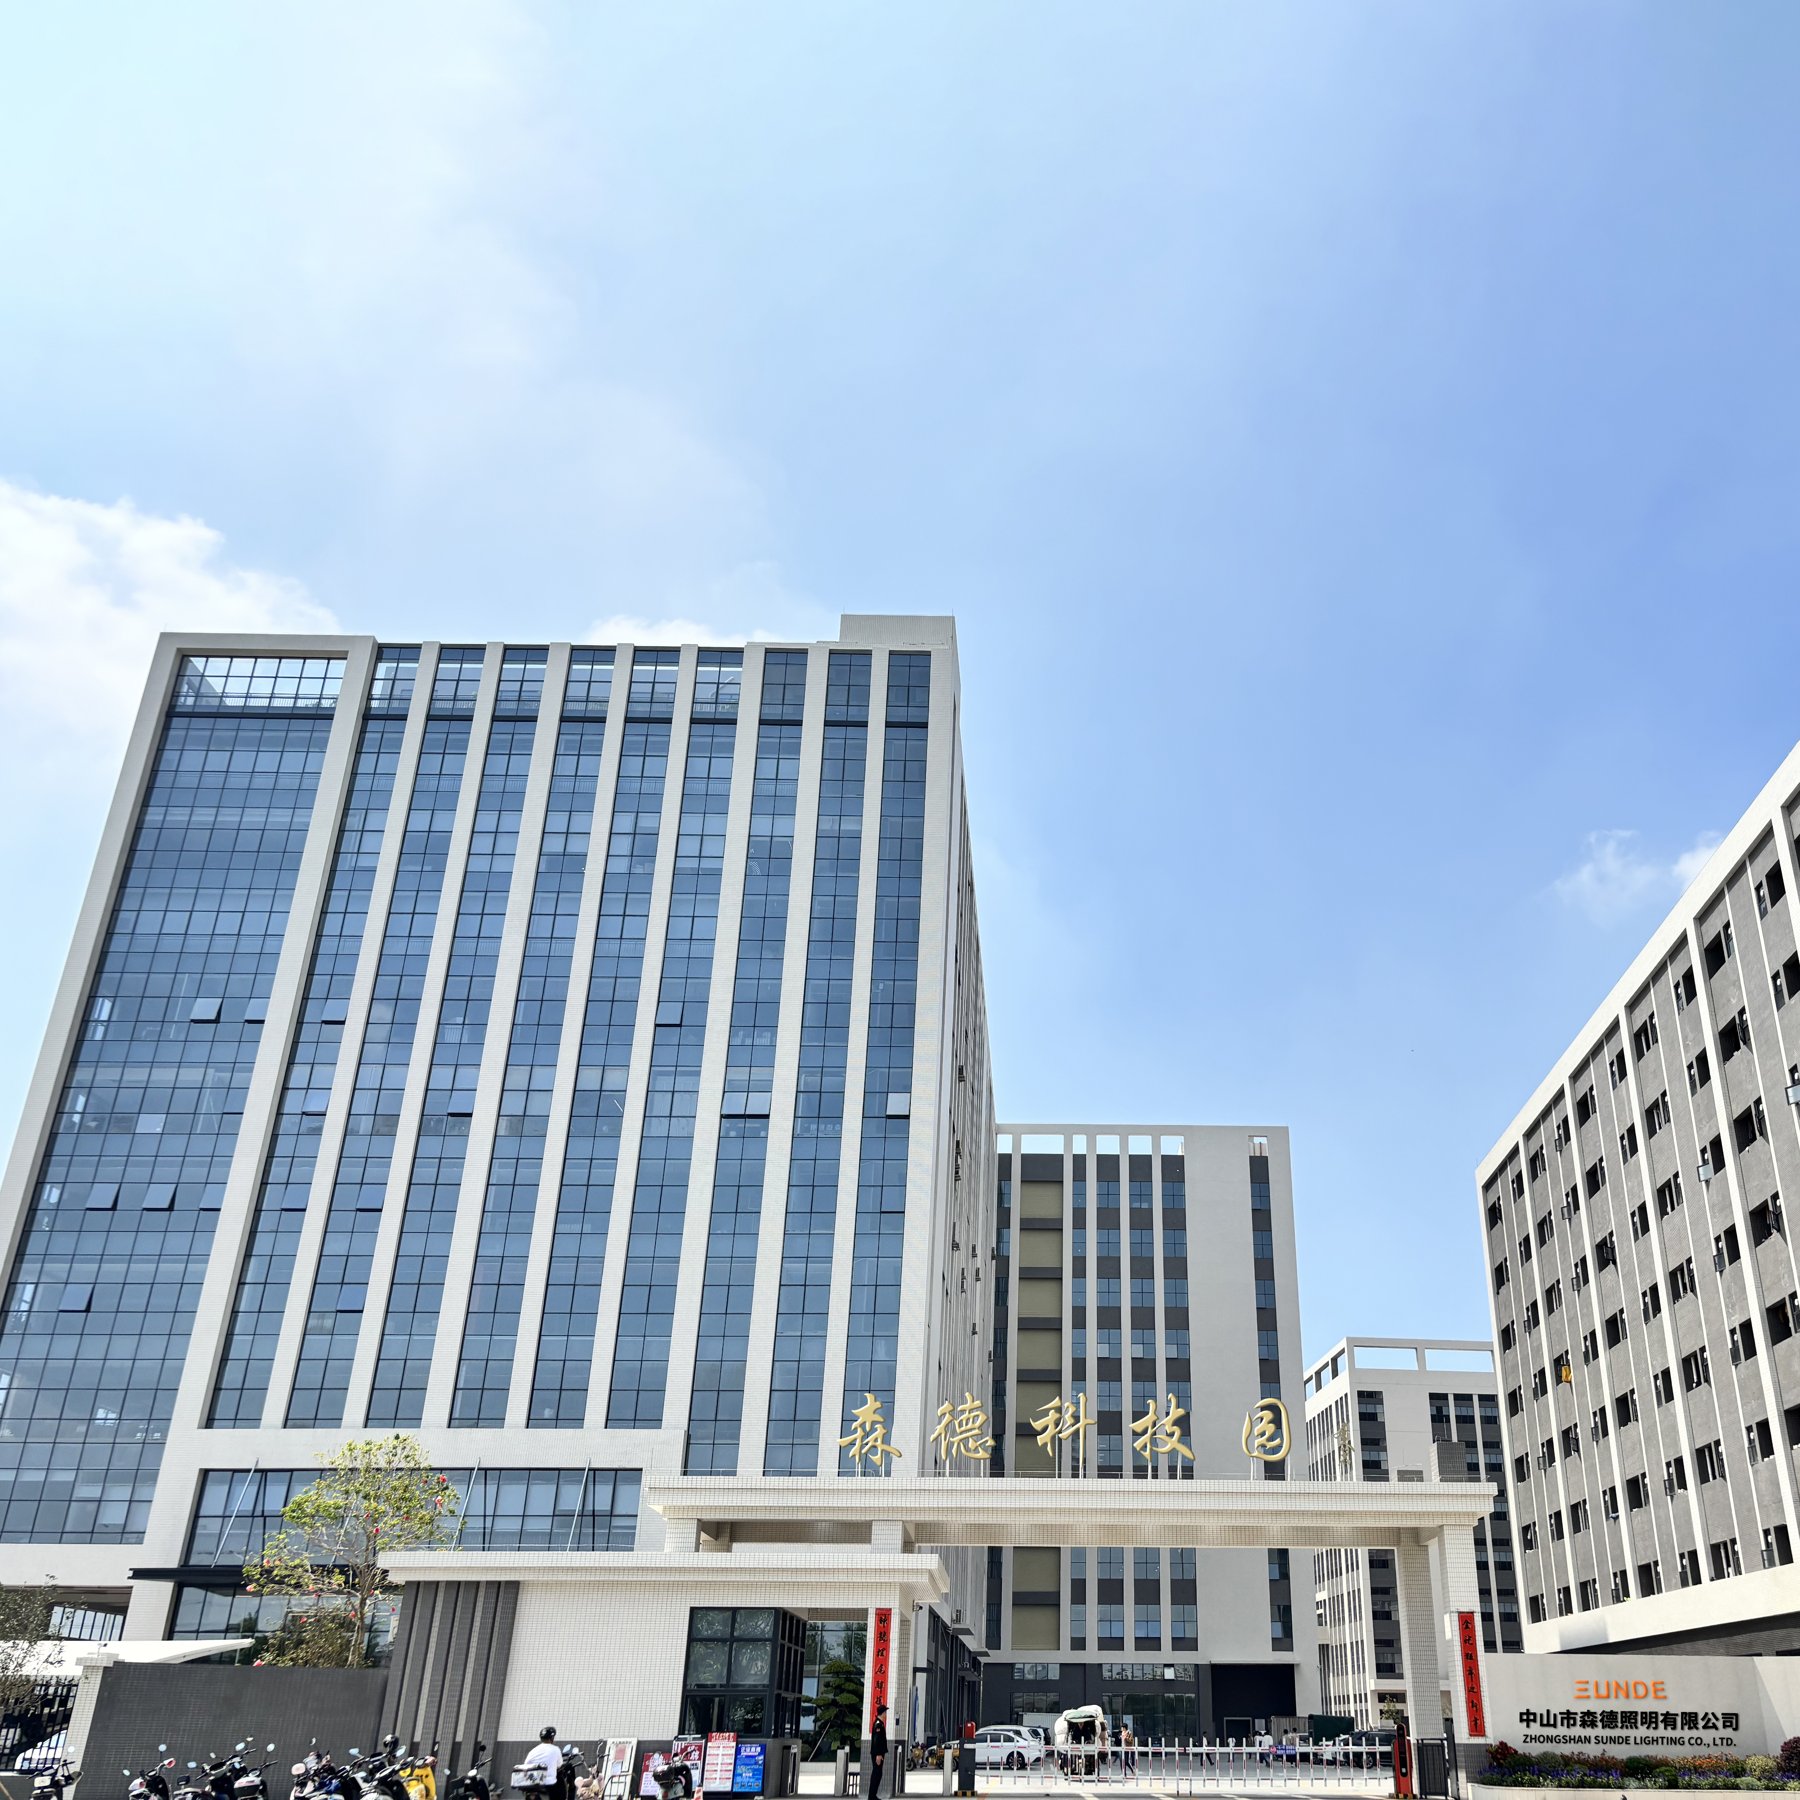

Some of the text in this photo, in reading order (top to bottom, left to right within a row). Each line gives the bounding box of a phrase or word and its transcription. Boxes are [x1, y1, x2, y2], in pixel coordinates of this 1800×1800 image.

[837, 1392, 1292, 1467] 森德科技园
[1519, 1709, 1740, 1732] 中山市森德照明有限公司
[1522, 1734, 1737, 1748] ZHONGSHAN SUNDE LIGHTING CO., LTD.
